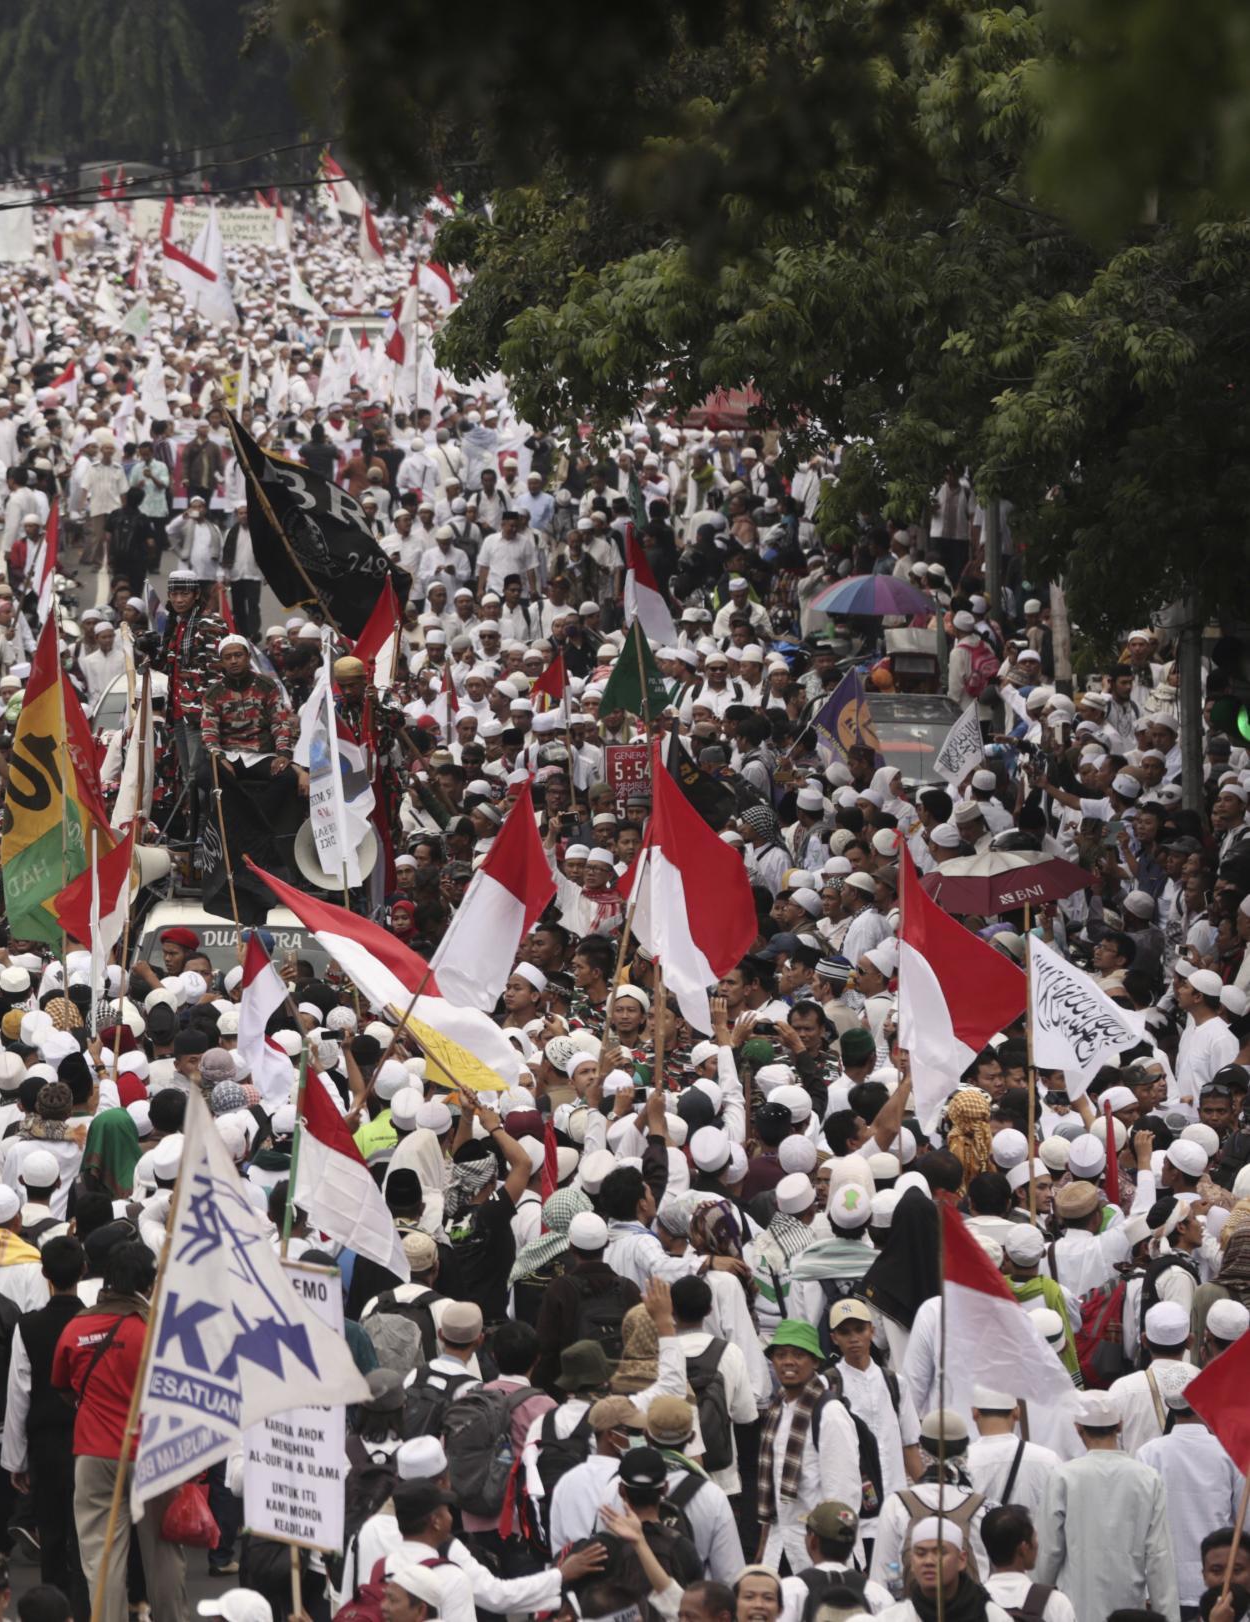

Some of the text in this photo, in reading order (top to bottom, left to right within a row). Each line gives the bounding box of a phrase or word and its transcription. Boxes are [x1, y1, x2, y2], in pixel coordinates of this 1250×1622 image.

[1015, 884, 1044, 901] BNI
[202, 930, 303, 948] DUA TRA
[292, 1278, 327, 1302] EMO
[150, 1371, 240, 1423] ESATUAN
[264, 1417, 325, 1442] KARENA AHOK
[272, 1437, 316, 1459] MENGHINA
[307, 1464, 340, 1480] ULAMA
[272, 1482, 317, 1503] UNTUK ITU
[266, 1498, 322, 1522] KAMI MOHON
[274, 1518, 316, 1539] KEADILAN
